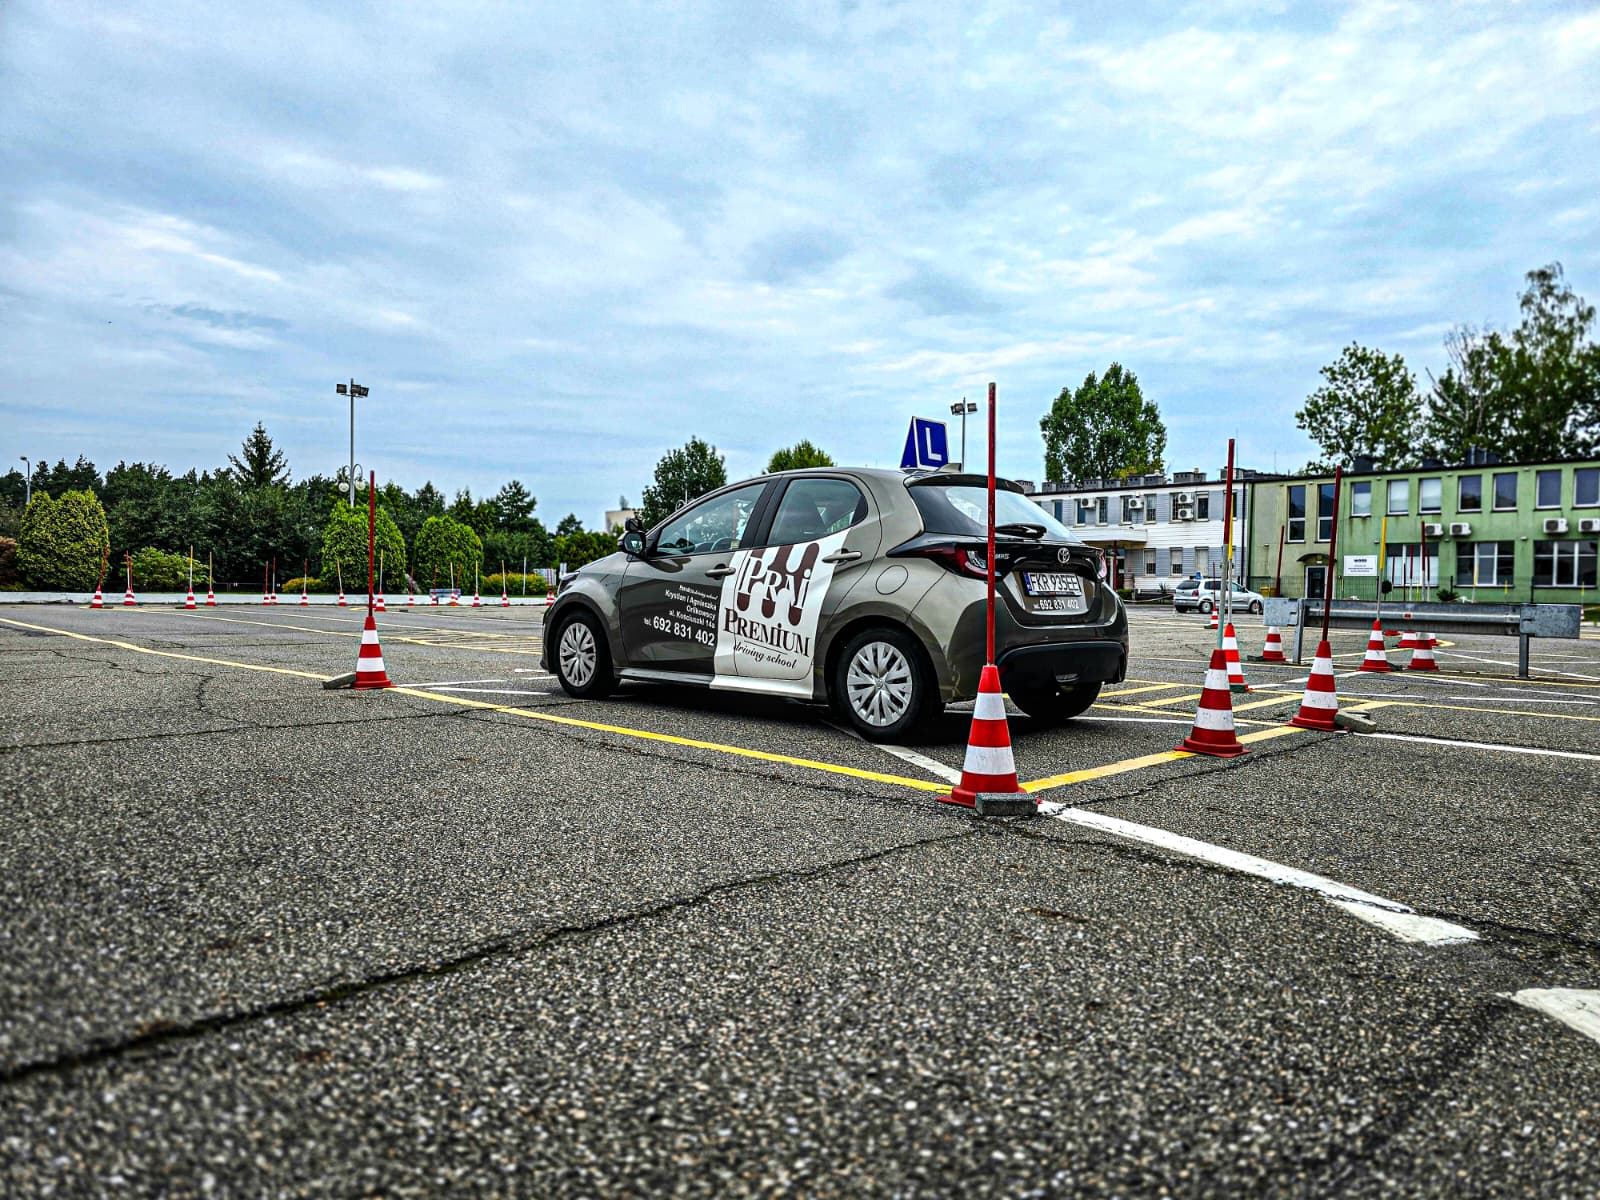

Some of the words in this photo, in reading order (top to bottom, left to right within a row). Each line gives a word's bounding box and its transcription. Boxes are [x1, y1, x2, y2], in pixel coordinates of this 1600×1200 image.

[925, 427, 942, 461] L
[1030, 574, 1050, 591] FKR
[1039, 599, 1053, 610] 692
[653, 615, 671, 633] 692
[674, 622, 692, 639] 831
[695, 629, 715, 647] 402
[734, 641, 765, 662] driving
[766, 652, 797, 669] school
